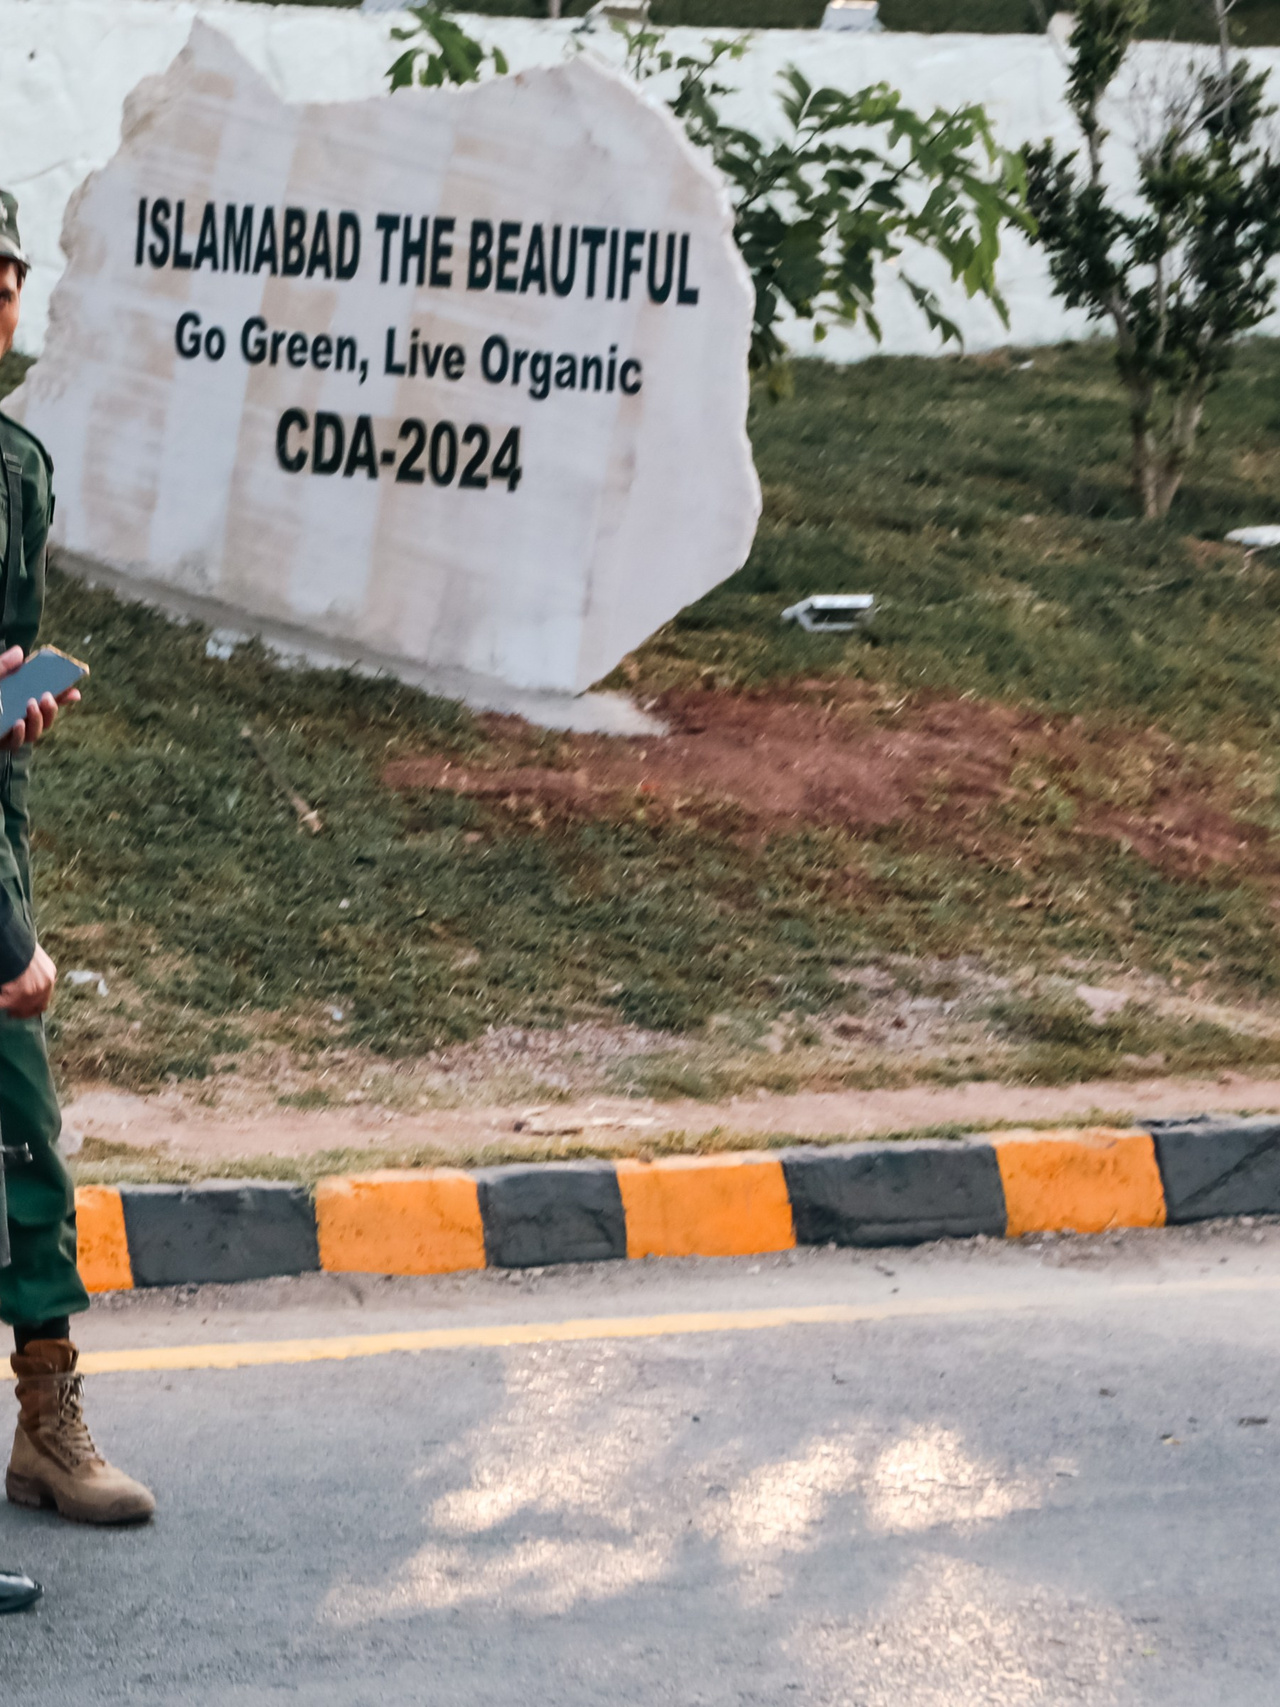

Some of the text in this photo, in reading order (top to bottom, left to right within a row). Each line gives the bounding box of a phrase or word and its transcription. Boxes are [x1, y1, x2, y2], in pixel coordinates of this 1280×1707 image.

[134, 197, 700, 306] ISLAMABAD THE BEAUTIFUL
[174, 312, 643, 400] Go Green, Live Organic
[275, 407, 523, 492] CDA-2024
